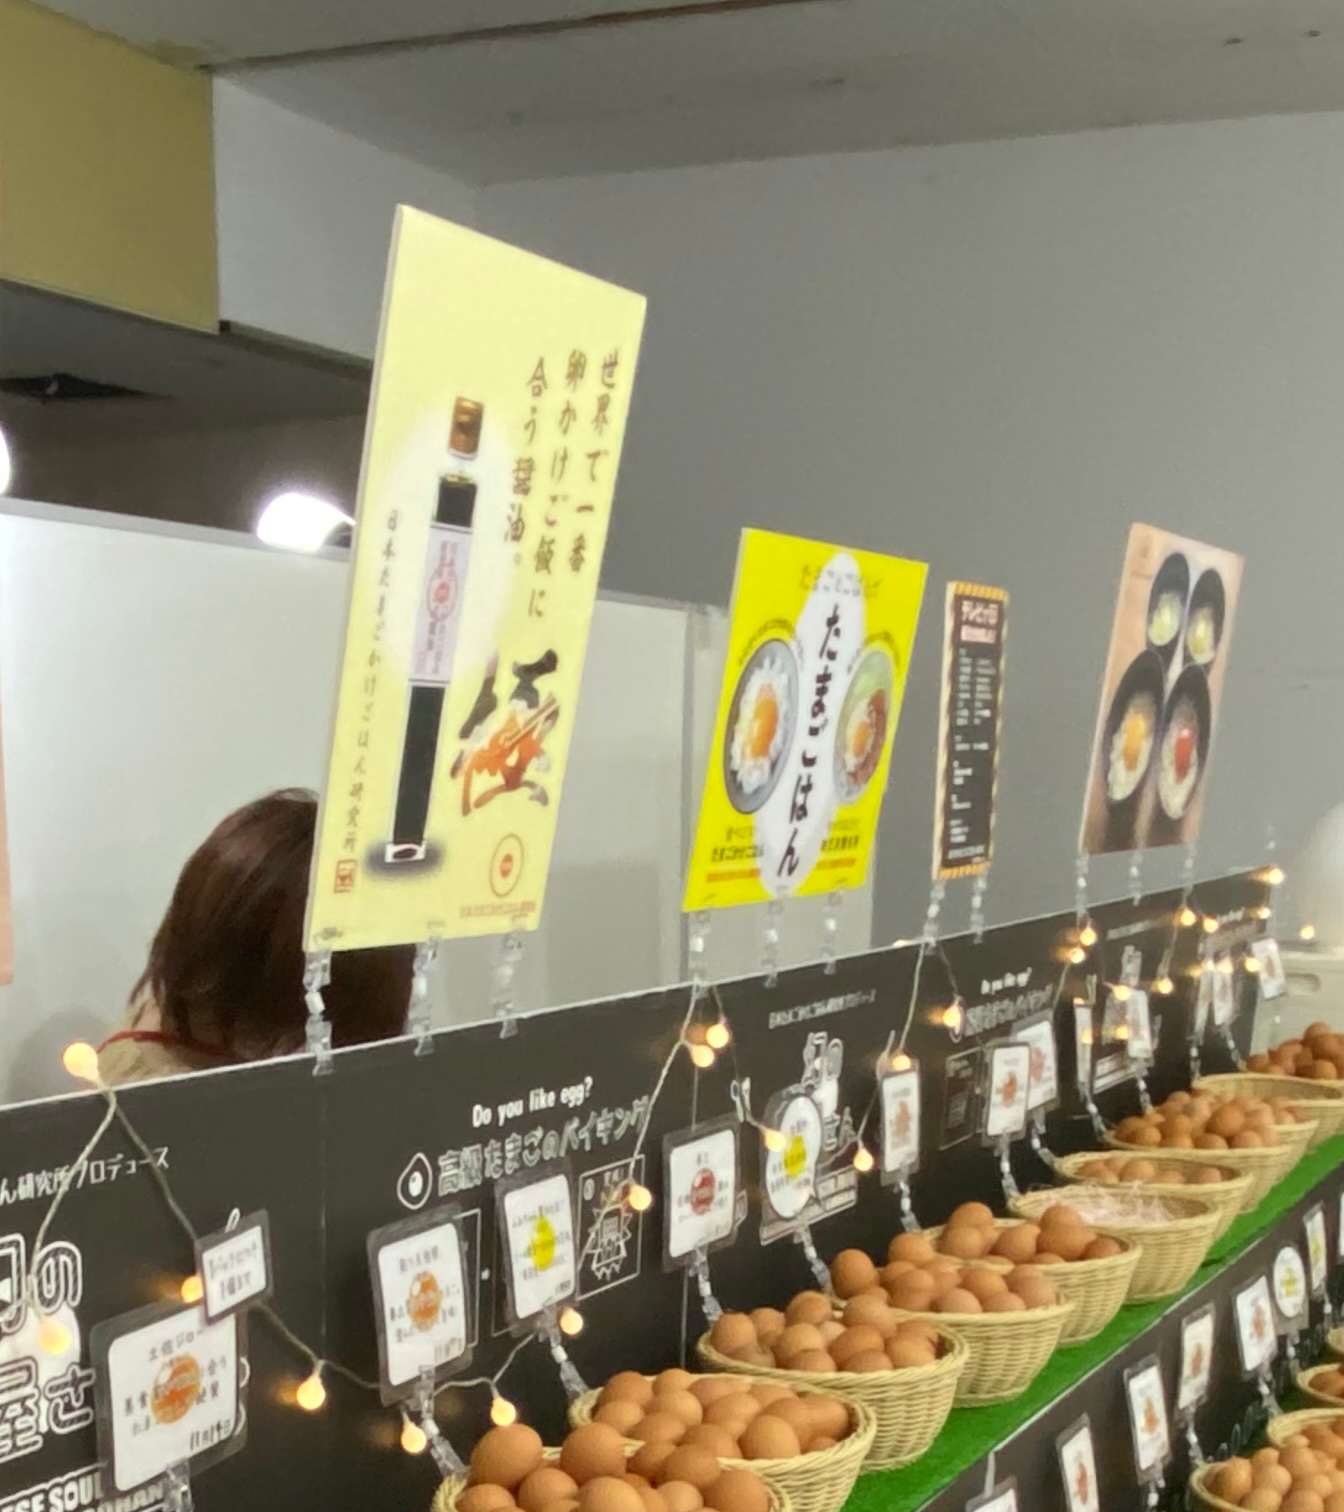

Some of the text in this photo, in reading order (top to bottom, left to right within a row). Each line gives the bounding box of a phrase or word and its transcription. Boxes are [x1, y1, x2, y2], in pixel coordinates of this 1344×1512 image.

[528, 350, 587, 618] 卵かけご飯に
[569, 350, 618, 575] 世界で一番
[777, 604, 842, 878] たまごはん
[472, 1075, 594, 1128] Do you like egg?
